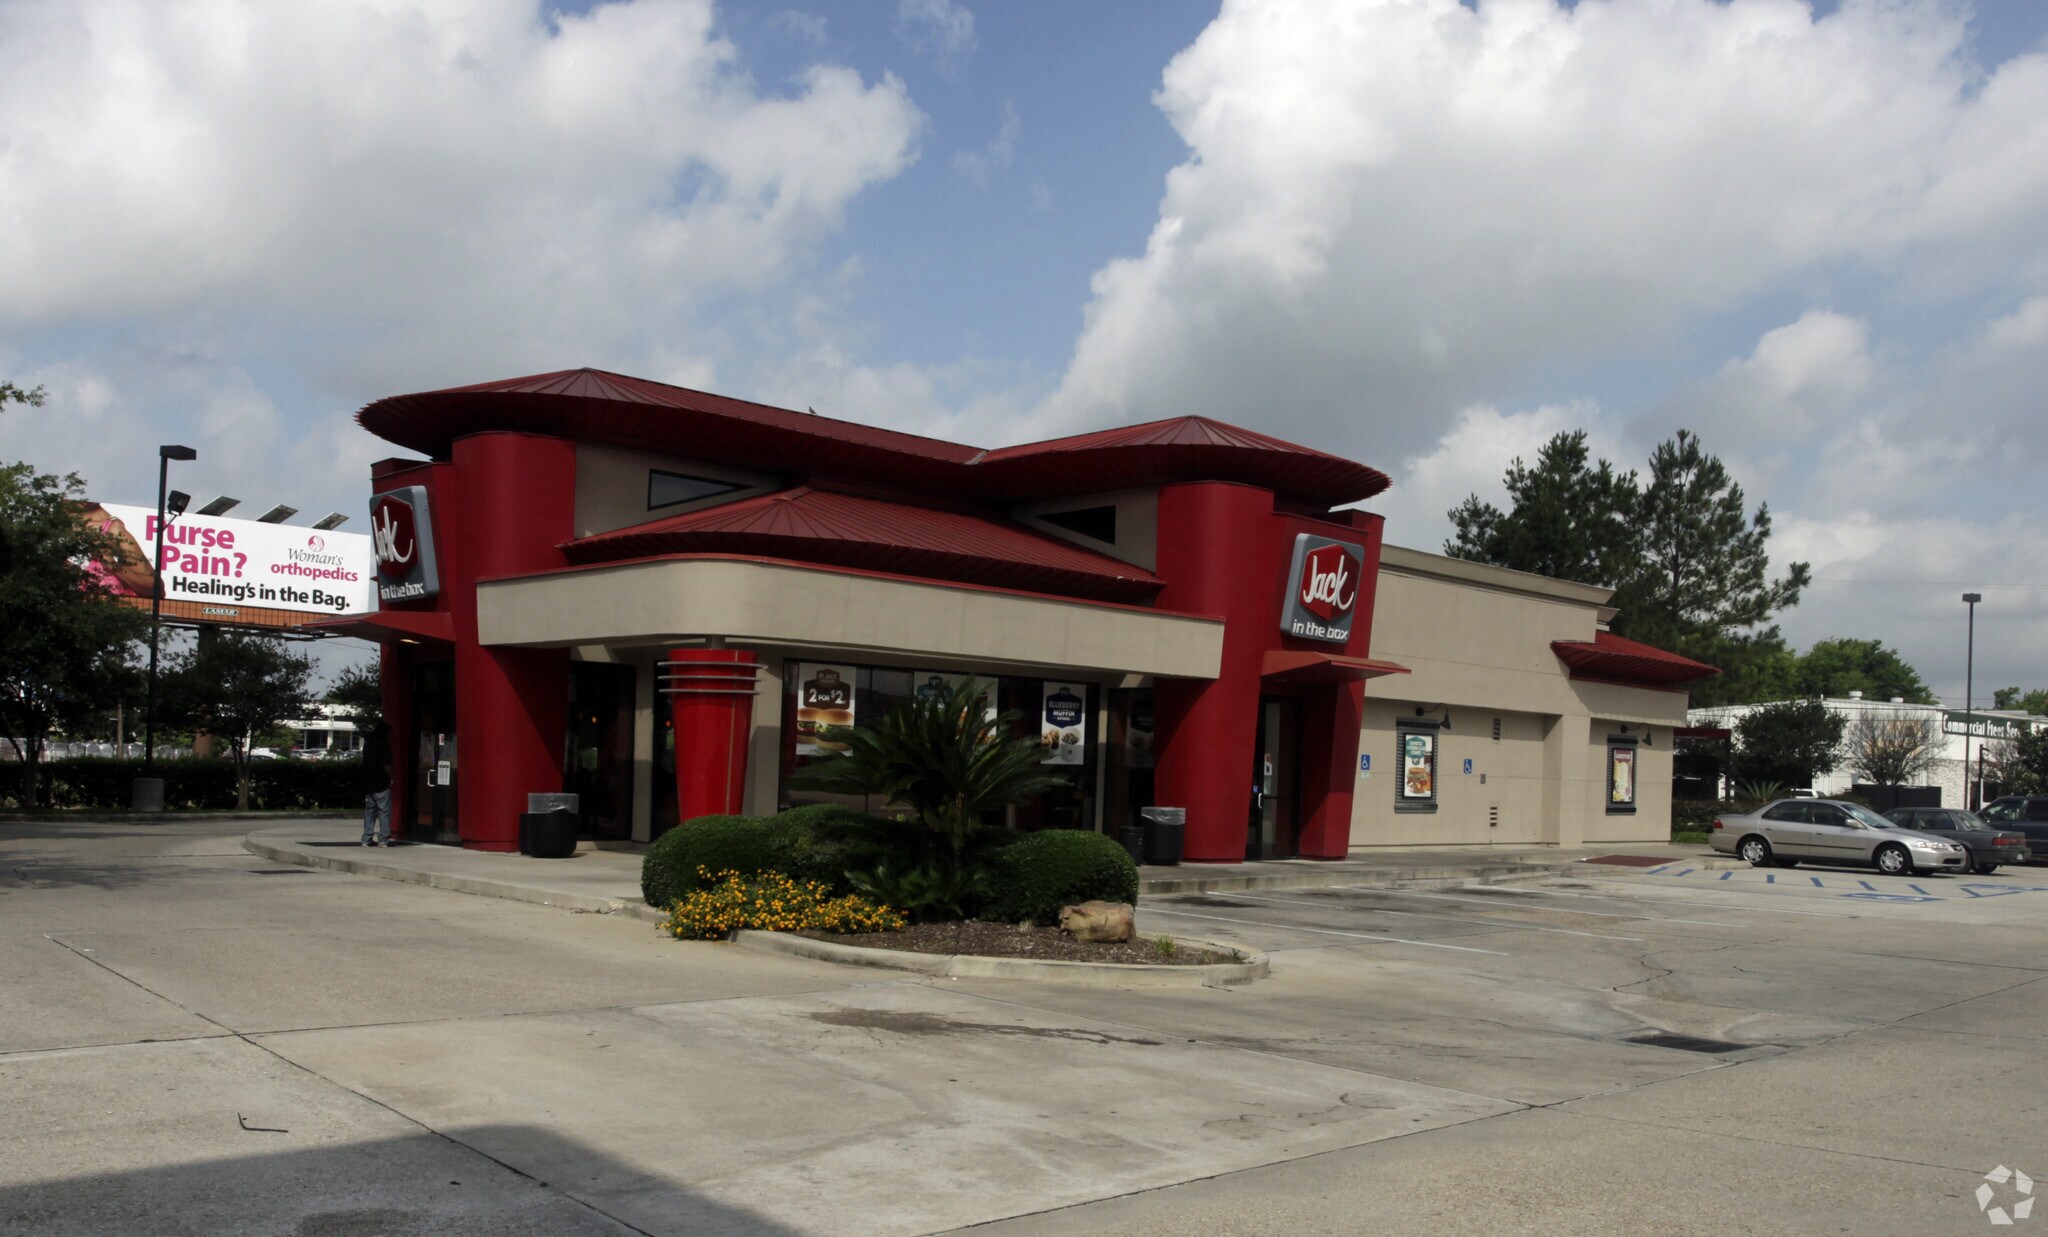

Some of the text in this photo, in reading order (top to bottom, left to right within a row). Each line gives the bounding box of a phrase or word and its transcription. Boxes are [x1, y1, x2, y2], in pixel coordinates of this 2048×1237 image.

[146, 515, 235, 549] Purse
[161, 545, 247, 578] Pain?
[288, 548, 343, 566] Woman's
[271, 562, 358, 582] orthopedics
[381, 582, 424, 599] in the box
[1303, 555, 1354, 610] Jack
[172, 576, 350, 610] Healing's in the Bag.
[1293, 619, 1348, 640] in the box
[809, 688, 817, 702] 2
[1049, 700, 1080, 709] BLUEBERRY
[1987, 720, 2004, 737] Fleet
